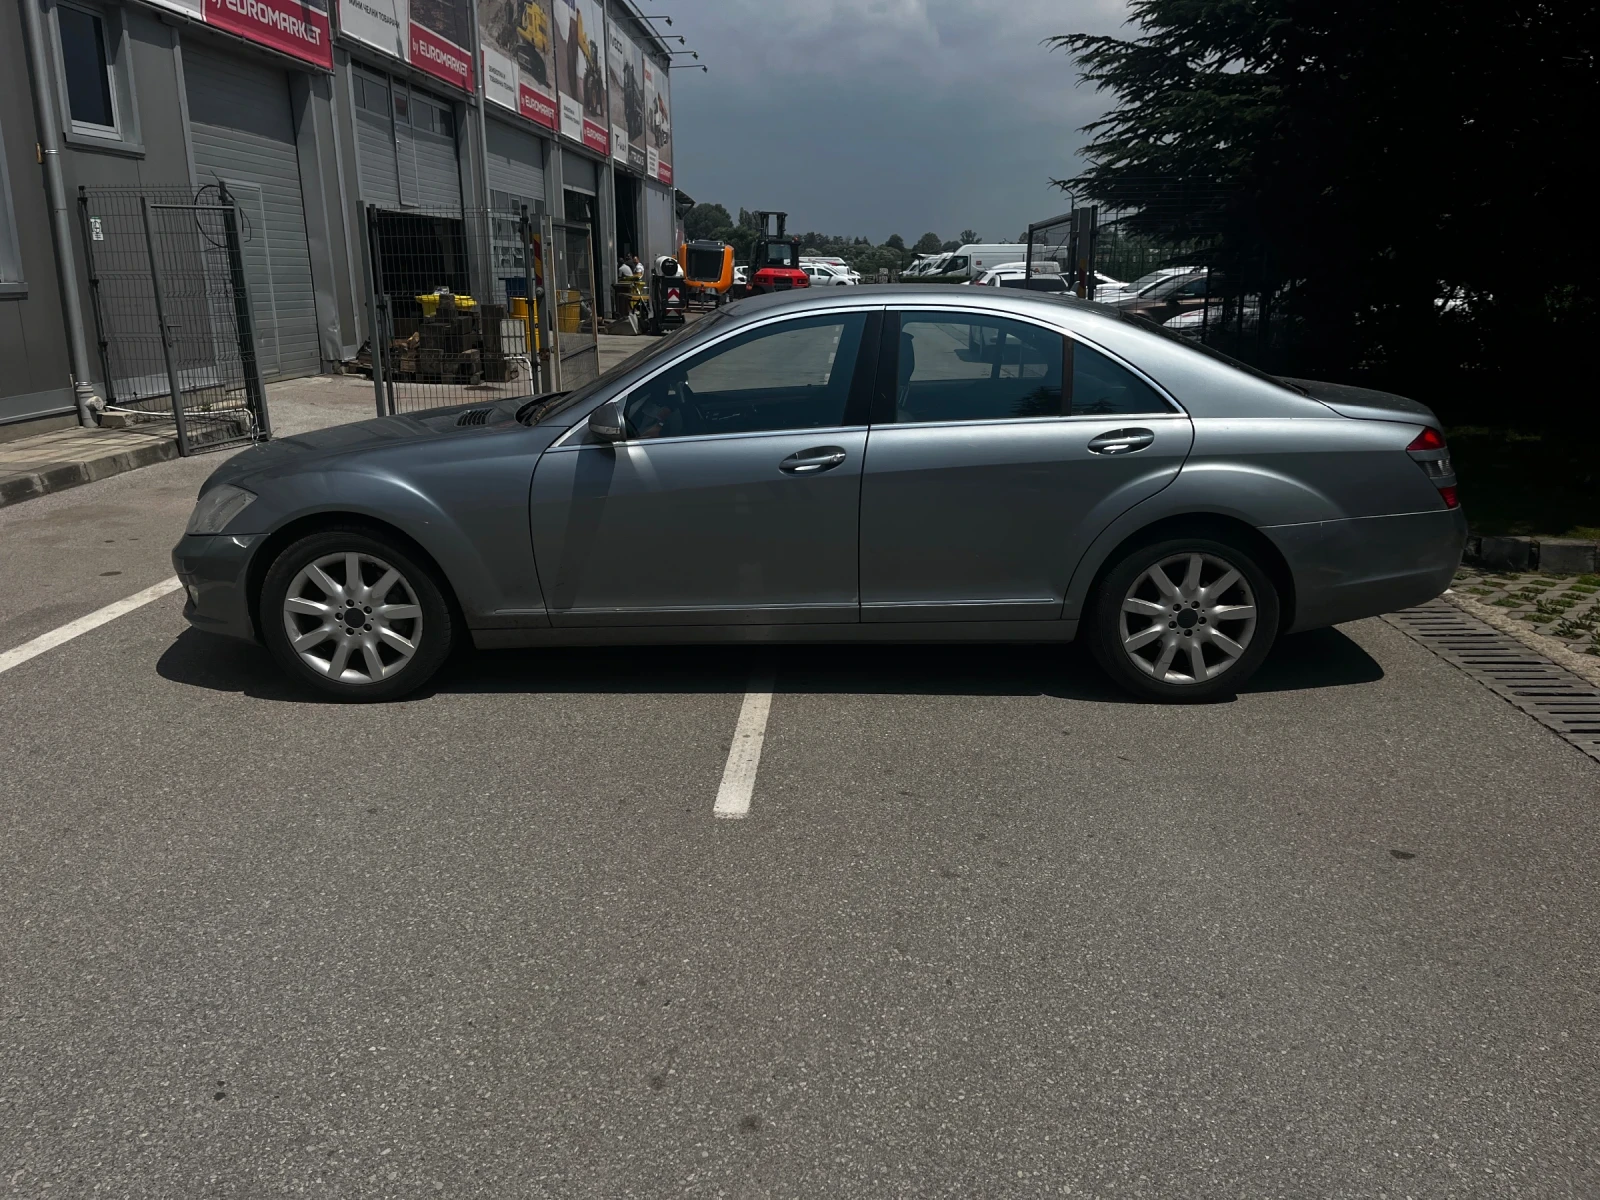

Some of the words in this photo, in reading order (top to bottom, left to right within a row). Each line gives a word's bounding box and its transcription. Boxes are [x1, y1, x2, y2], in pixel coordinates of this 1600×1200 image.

[226, 0, 321, 45] EUROMARKET
[412, 37, 419, 55] by
[419, 39, 468, 77] EUROMARKET
[525, 95, 554, 120] EUROMARKET
